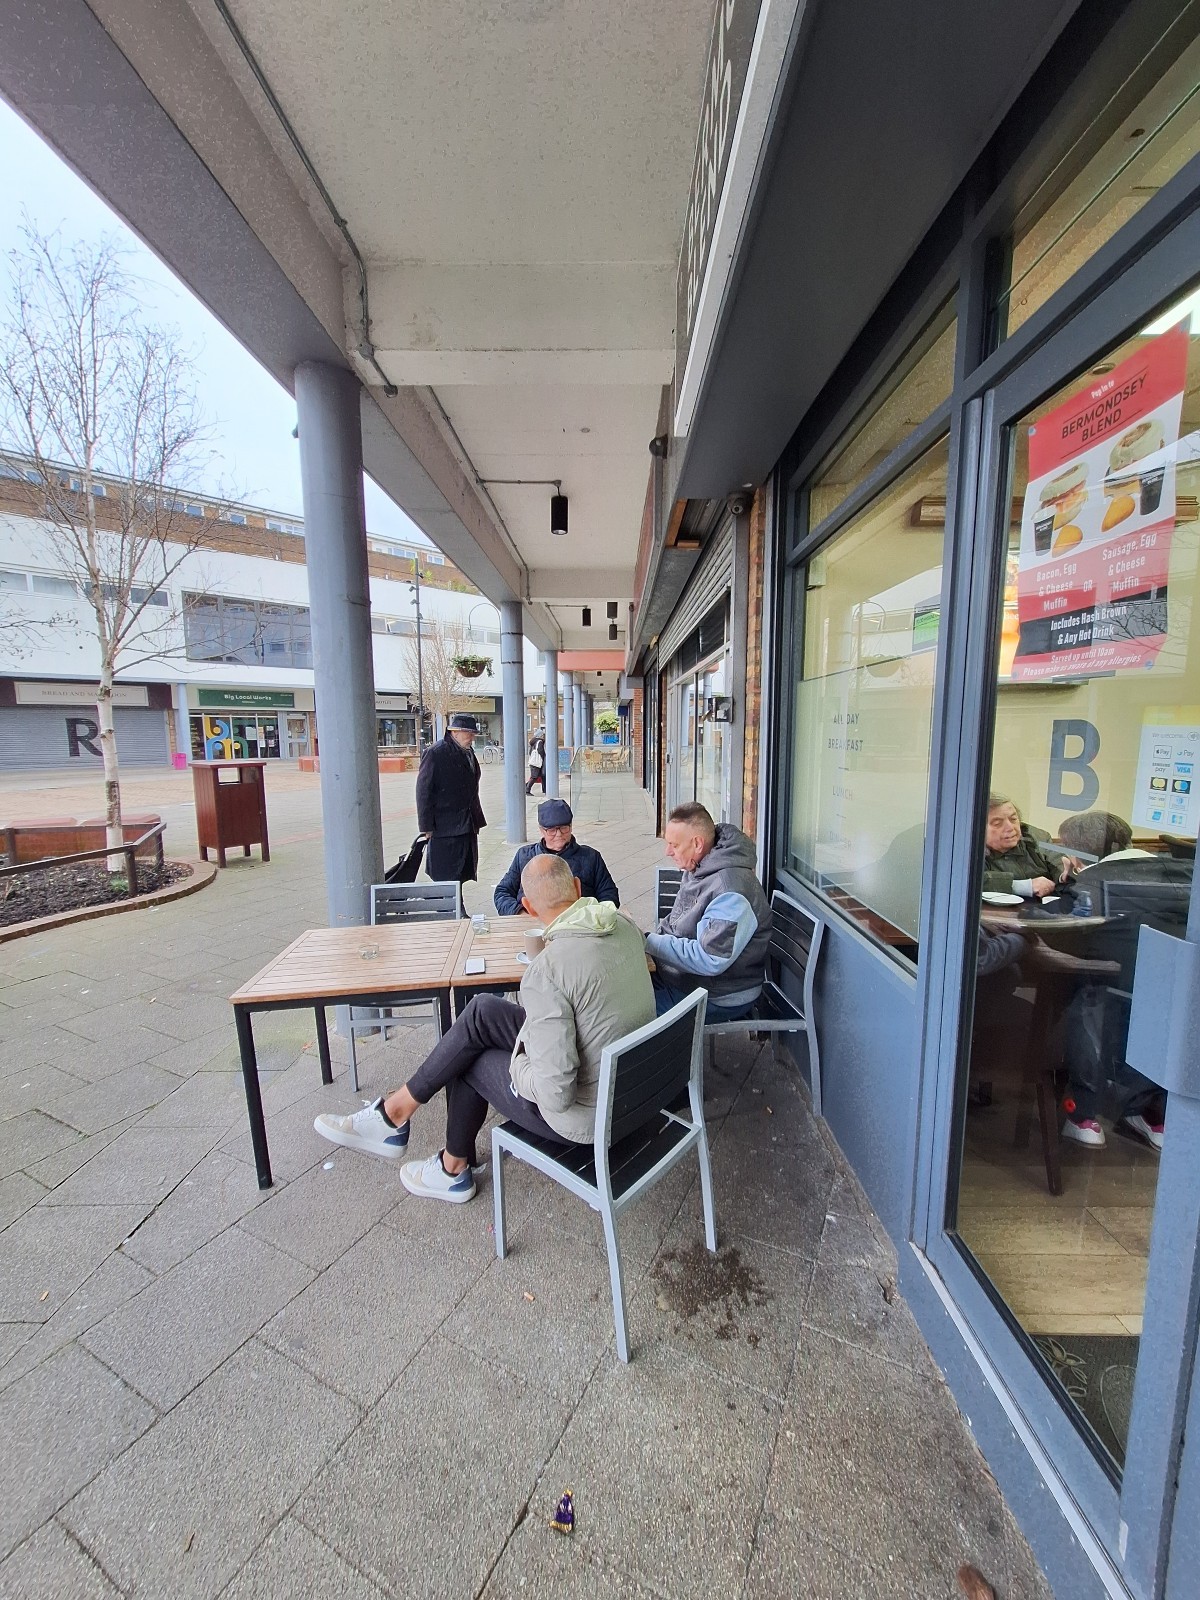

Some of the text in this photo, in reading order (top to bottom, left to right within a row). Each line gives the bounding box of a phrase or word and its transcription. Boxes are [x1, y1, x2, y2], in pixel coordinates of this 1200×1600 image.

[687, 59, 732, 336] BLEND
[1062, 373, 1148, 439] BERMONDSEY
[1081, 408, 1122, 442] BLEND
[1102, 532, 1157, 561] Sausage, Egg
[1036, 562, 1077, 582] Bacon, Egg
[1108, 555, 1146, 577] & Cheese
[1038, 580, 1093, 596] & Cheese OR
[1111, 575, 1139, 593] Muffin
[1043, 596, 1068, 612] Muffin
[1051, 605, 1127, 631] Includes Hash Brown
[1057, 624, 1115, 645] & Any Hot Drink
[1023, 666, 1044, 676] Please
[1095, 659, 1107, 669] any
[1107, 653, 1142, 666] allergies
[1051, 647, 1115, 664] Served up until 10am
[224, 693, 235, 701] Big
[846, 713, 860, 725] DAY
[65, 717, 103, 757] R
[1046, 719, 1101, 812] B
